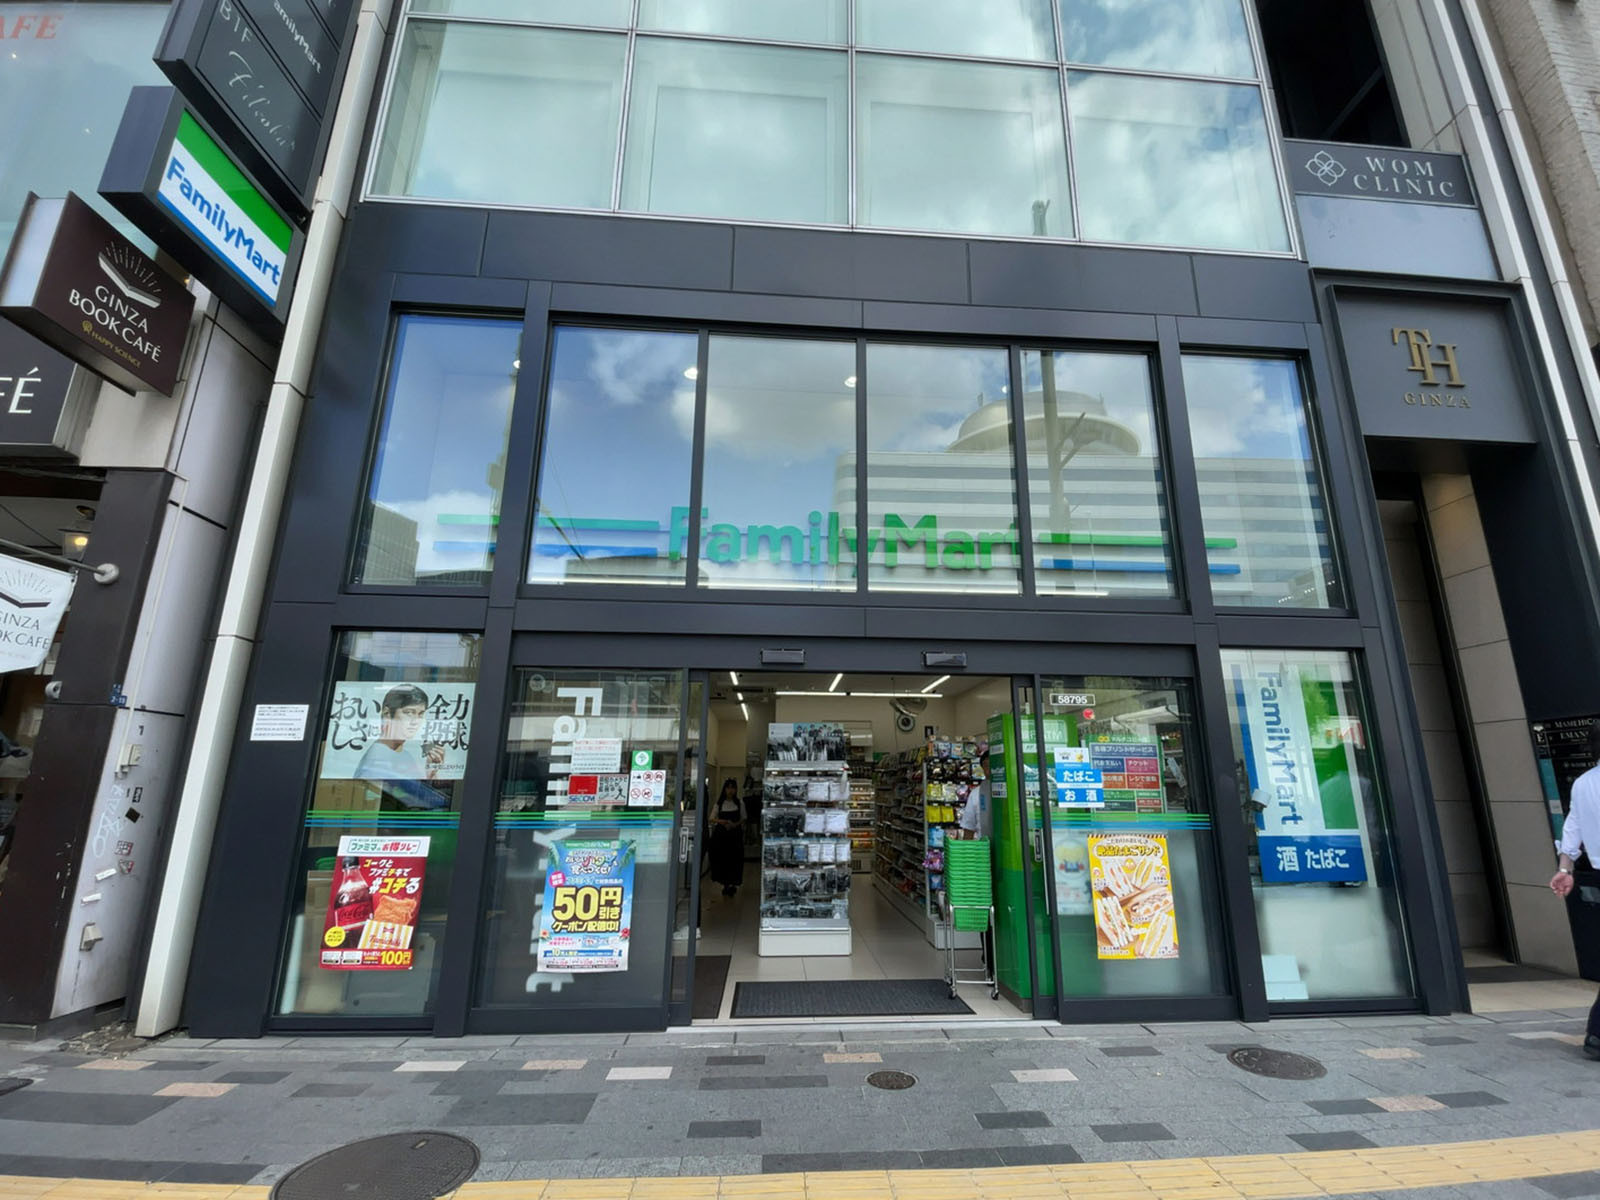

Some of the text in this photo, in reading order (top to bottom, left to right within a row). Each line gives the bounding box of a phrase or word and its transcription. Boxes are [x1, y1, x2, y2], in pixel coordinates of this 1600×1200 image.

[273, 0, 321, 73] amilyMart
[1366, 156, 1434, 177] WOM
[1353, 174, 1456, 198] CLINIC
[166, 157, 281, 286] FamilyMart
[95, 285, 149, 333] GINZA
[1404, 391, 1472, 408] GINZA
[428, 693, 470, 720] 全力
[1057, 695, 1088, 704] 58795
[1258, 671, 1304, 826] FamilyMart
[1063, 770, 1095, 782] たばこ
[1275, 846, 1350, 872] 酒 たばこ
